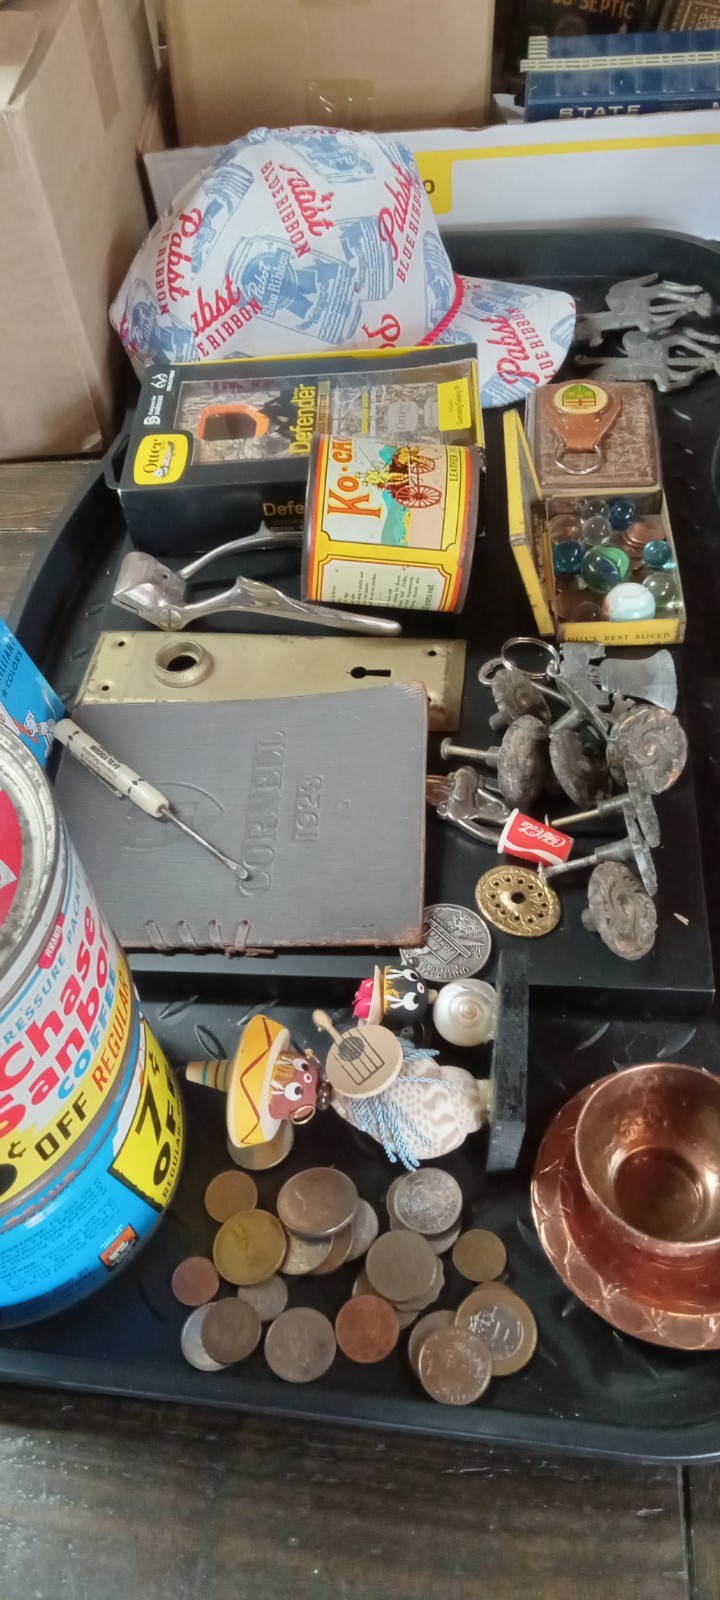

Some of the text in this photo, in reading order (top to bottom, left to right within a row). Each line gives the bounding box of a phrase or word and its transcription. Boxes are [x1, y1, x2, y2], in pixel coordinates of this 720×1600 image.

[579, 0, 634, 19] SEPTIC
[559, 104, 641, 119] STATE
[275, 195, 312, 258] RIBBON
[377, 162, 412, 261] Pabst
[155, 248, 170, 315] RIBBON
[167, 208, 202, 302] Pabst
[250, 261, 271, 299] Pabst
[269, 252, 289, 293] Ribbon
[396, 233, 415, 283] BLUE
[191, 274, 241, 337] abst
[208, 297, 263, 351] RIBBON
[481, 315, 540, 385] Pabst
[506, 307, 558, 380] LUE RIBBON
[289, 383, 316, 454] Defender
[143, 439, 162, 474] Otter
[262, 501, 306, 517] Defe
[635, 632, 670, 640] SLICED
[6, 651, 23, 689] COLORS
[239, 728, 288, 897] CORNELL
[45, 925, 62, 958] BRAND
[0, 906, 96, 1092] Chase
[0, 917, 109, 1140] Sanbor
[3, 952, 66, 1044] RESSURE
[58, 962, 116, 1100] COFFEE
[34, 1091, 88, 1162] OFF
[91, 974, 130, 1093] REGULAR
[162, 1127, 182, 1199] REGULAR
